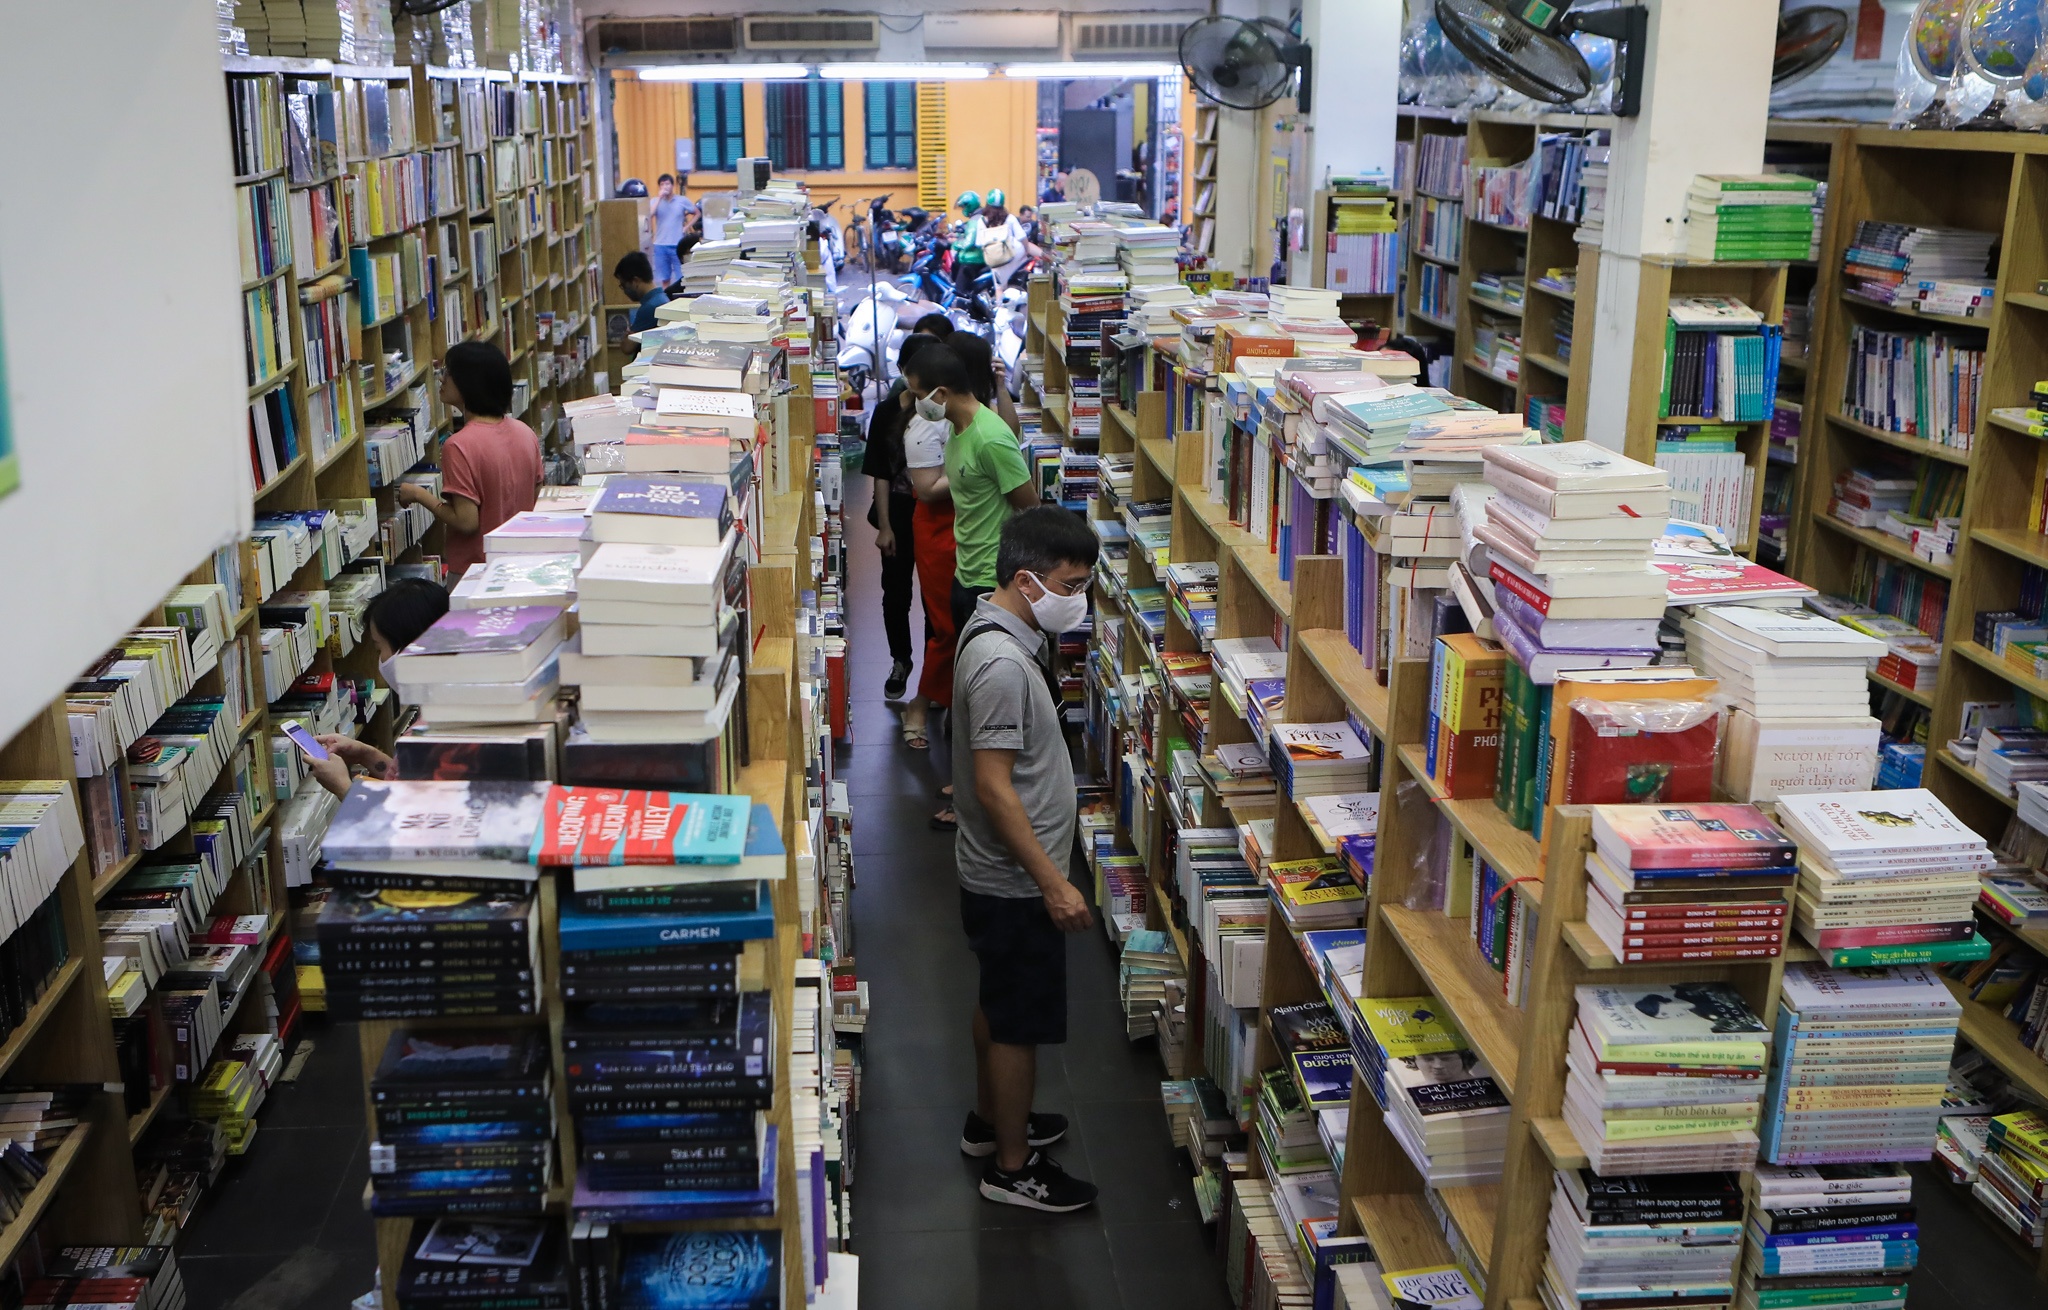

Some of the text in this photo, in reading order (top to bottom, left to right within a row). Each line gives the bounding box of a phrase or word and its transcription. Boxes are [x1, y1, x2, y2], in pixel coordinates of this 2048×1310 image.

[662, 348, 716, 357] WARREN
[1774, 750, 1813, 761] NGƯỜI
[1838, 748, 1862, 760] TỐT
[1799, 764, 1819, 773] hơn
[1770, 776, 1804, 791] người
[1839, 773, 1856, 785] tốt
[558, 795, 588, 846] DECODING
[640, 804, 671, 841] VALLEY
[659, 927, 720, 941] CARMEN
[1274, 1005, 1303, 1015] Ajahn
[1450, 1078, 1491, 1091] NGHĨA
[1690, 1106, 1709, 1115] bên
[1711, 1106, 1727, 1115] kia
[1640, 1212, 1659, 1220] Hiện
[1876, 1213, 1897, 1222] người
